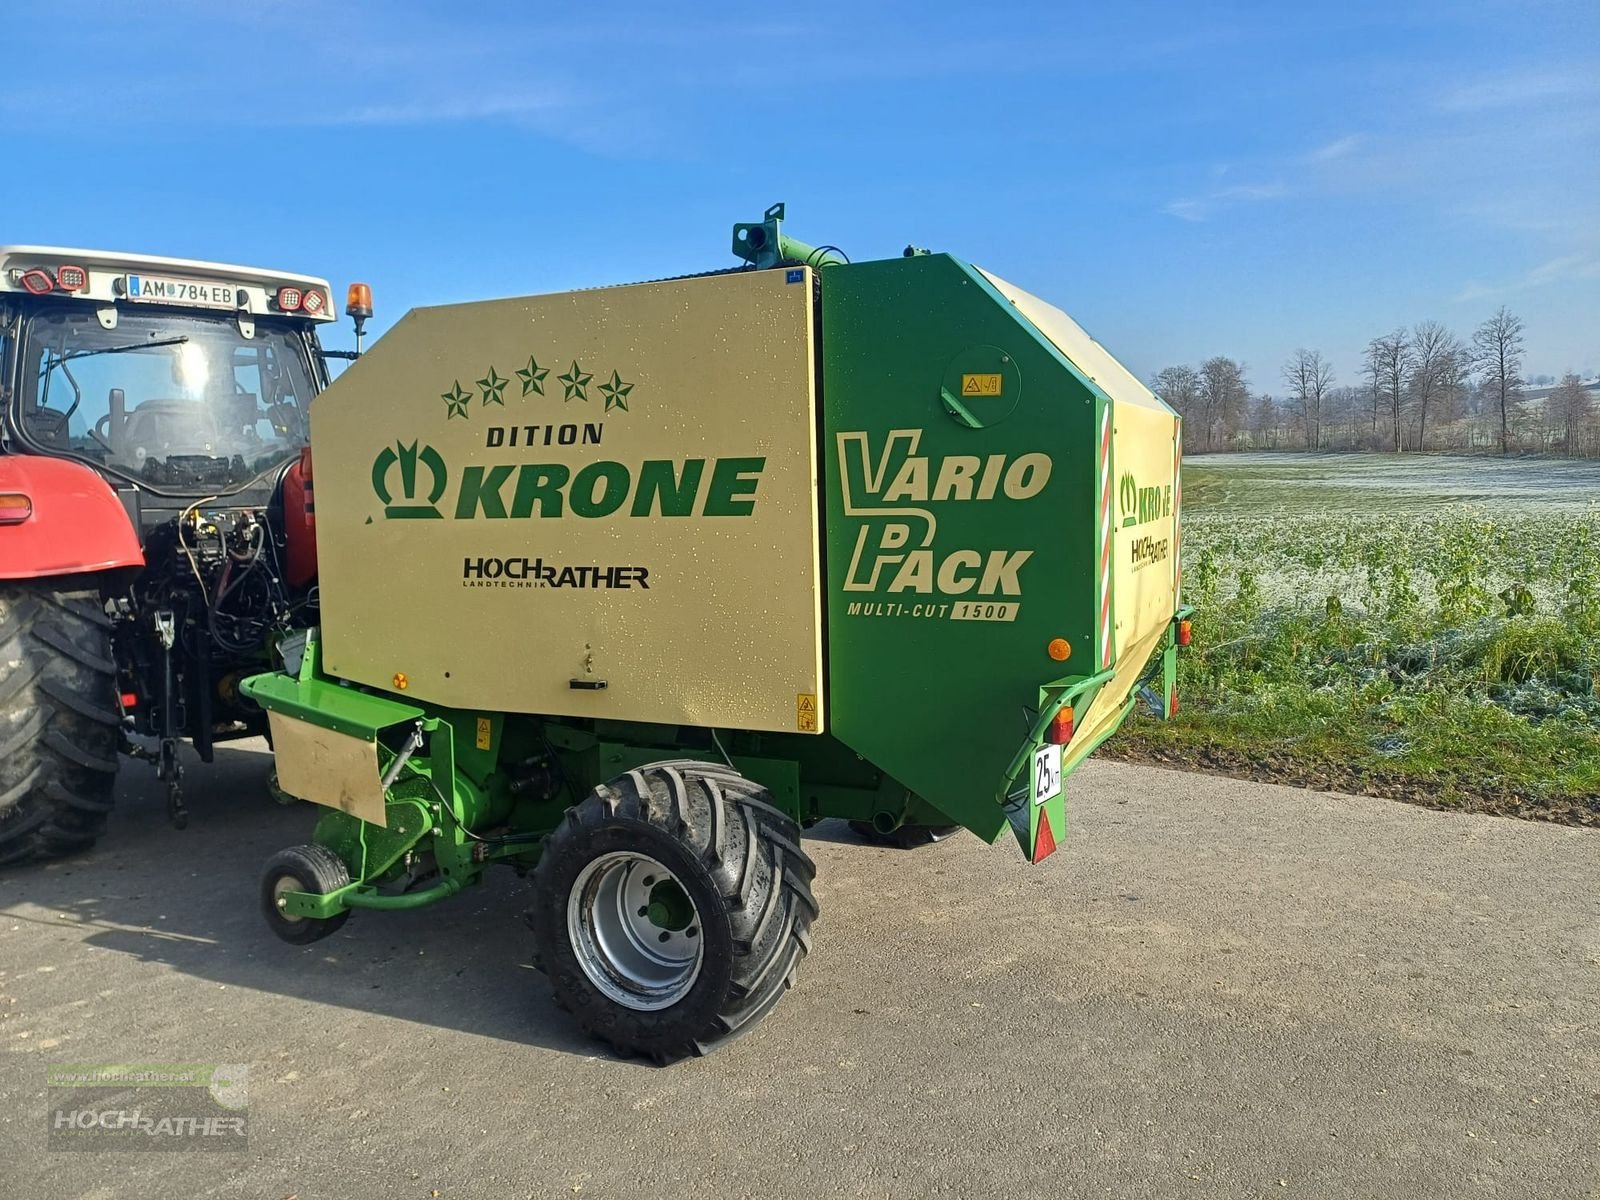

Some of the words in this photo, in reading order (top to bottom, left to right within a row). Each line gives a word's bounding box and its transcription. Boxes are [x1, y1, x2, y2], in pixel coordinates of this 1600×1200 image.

[142, 280, 165, 297] AM
[178, 283, 208, 301] 784
[212, 287, 232, 303] EB
[486, 423, 603, 447] DITION
[455, 456, 766, 520] KRONE
[836, 429, 1053, 516] VARIO
[843, 508, 1035, 595] PACK
[463, 557, 650, 589] HOCHRATHER
[463, 580, 546, 588] LANDTECHNIK
[847, 602, 949, 618] MULTI-CUT
[961, 604, 1008, 619] 1500
[1036, 753, 1050, 798] 25
